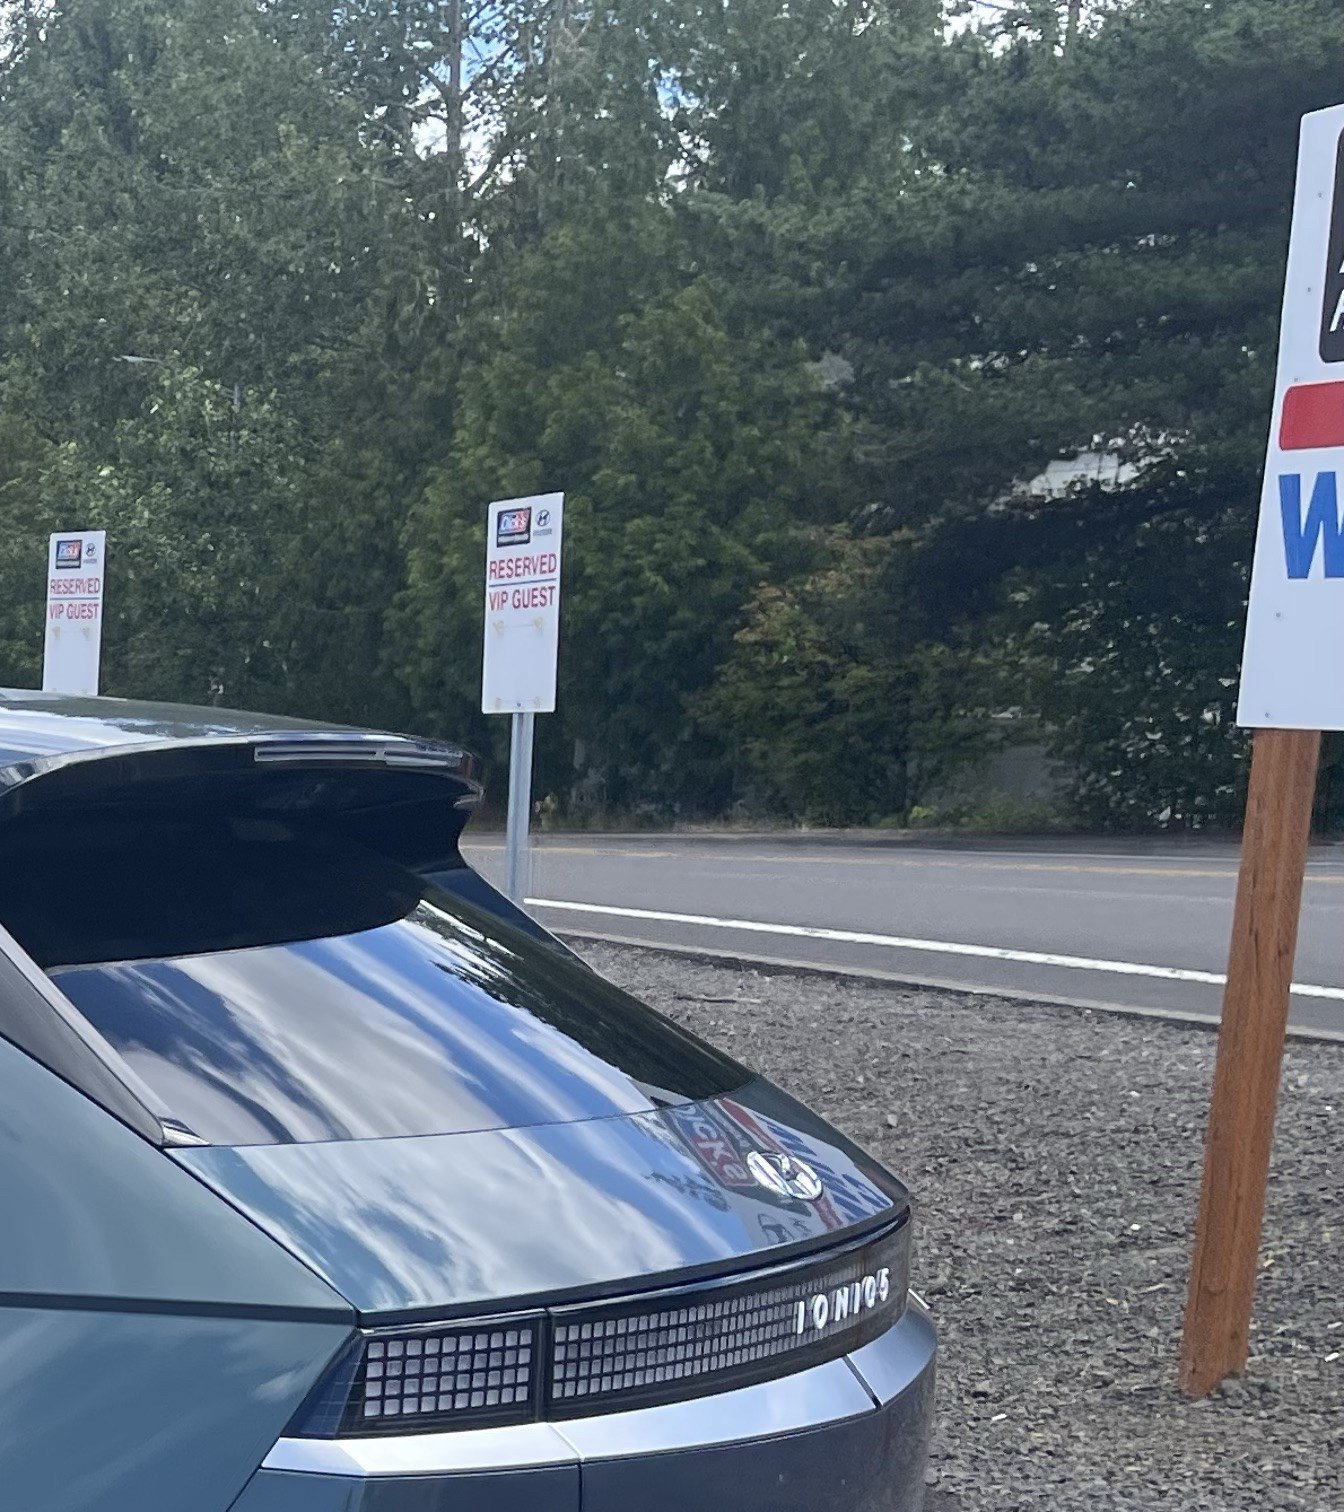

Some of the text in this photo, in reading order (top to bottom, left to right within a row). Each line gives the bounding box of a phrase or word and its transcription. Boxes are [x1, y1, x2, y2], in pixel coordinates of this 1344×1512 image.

[489, 553, 557, 580] RESERVED
[50, 577, 100, 594] RESERVED
[489, 585, 556, 611] VIP GUEST
[66, 603, 99, 619] GUEST
